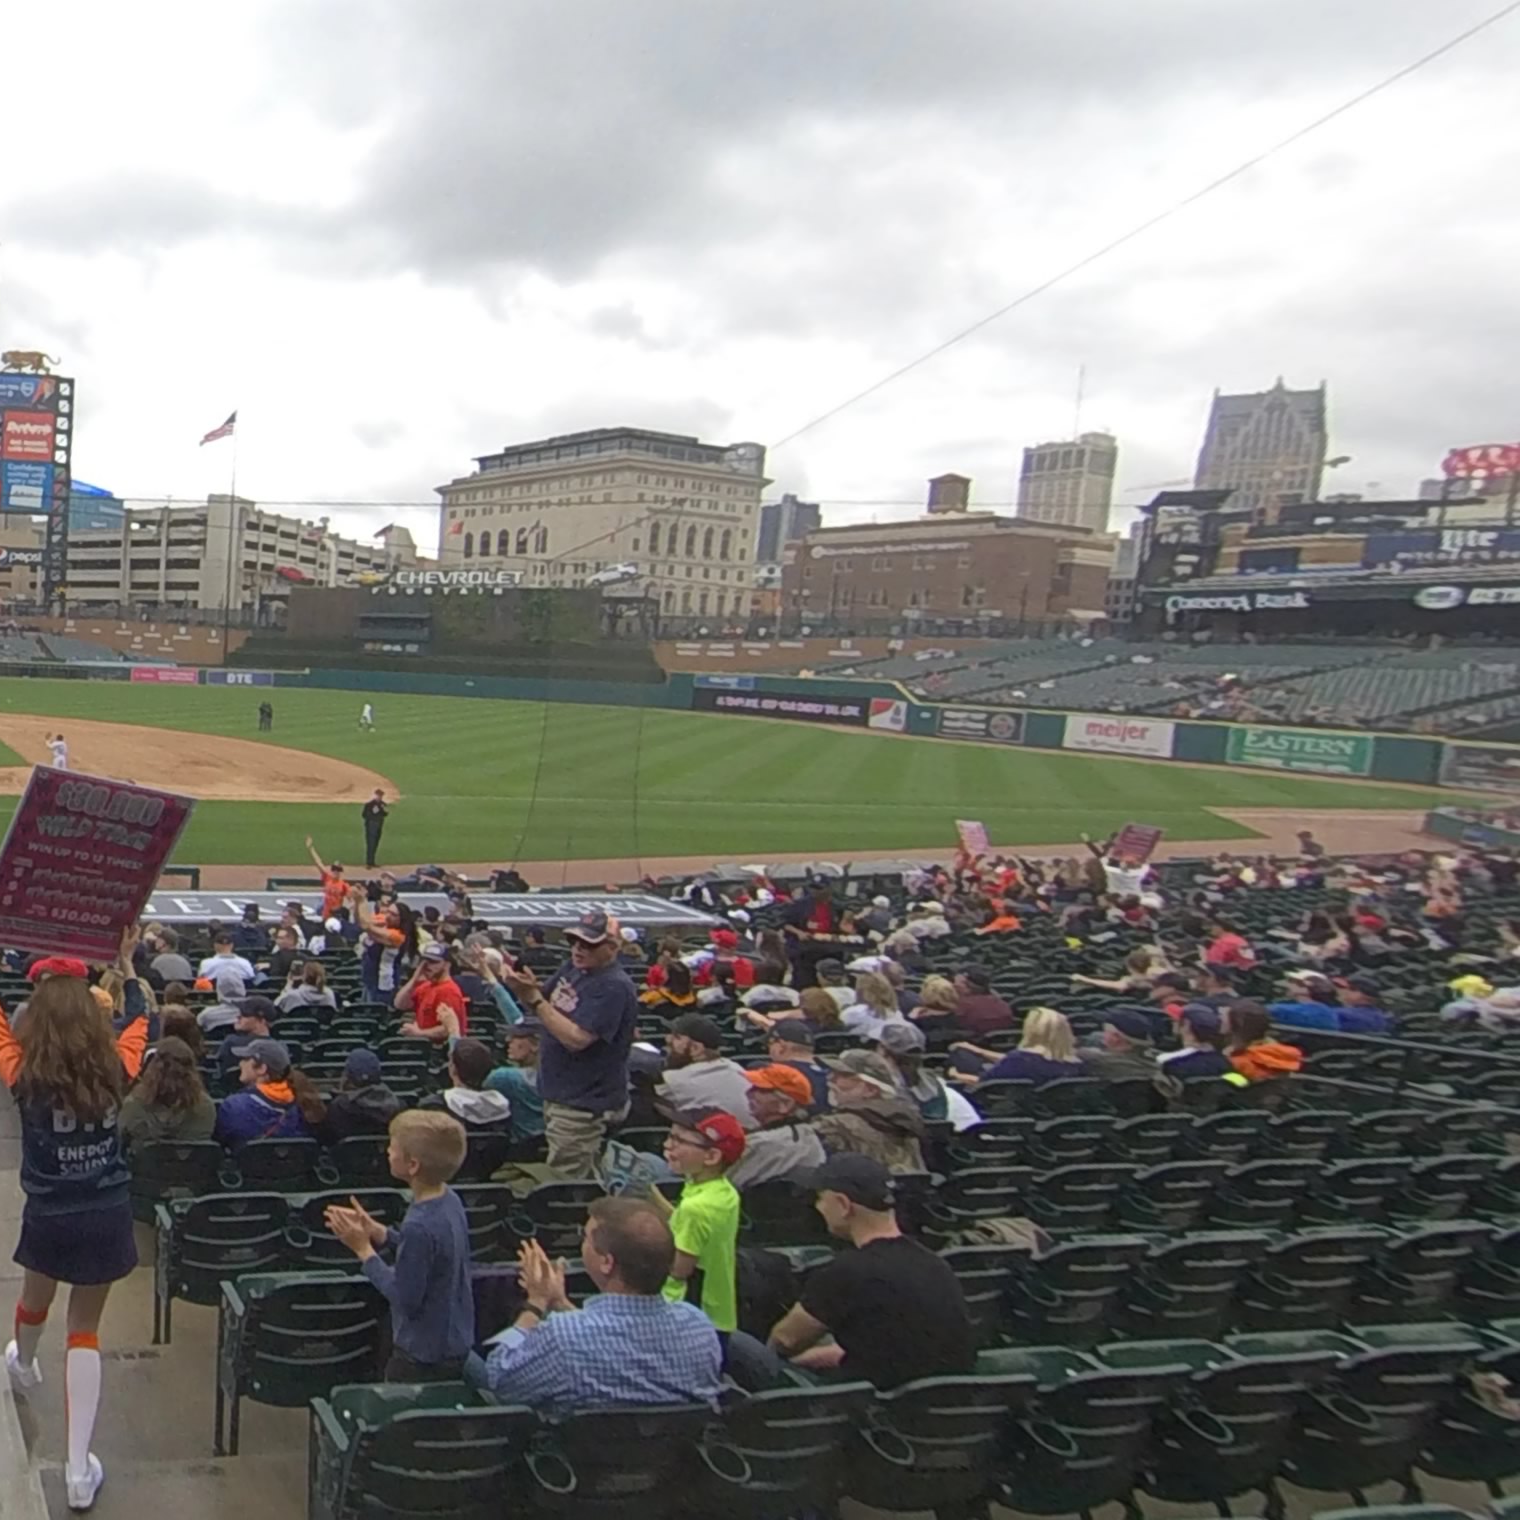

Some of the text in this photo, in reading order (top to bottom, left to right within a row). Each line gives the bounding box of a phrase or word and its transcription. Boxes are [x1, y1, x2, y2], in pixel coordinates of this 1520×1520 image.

[9, 551, 41, 564] pepsi
[396, 571, 524, 585] CHEVROLET
[1255, 592, 1310, 608] Bank
[227, 673, 253, 684] DTE
[1086, 721, 1150, 742] meijer
[1244, 728, 1357, 754] EASTERN
[28, 842, 53, 856] WIN
[54, 845, 72, 858] UP
[74, 849, 90, 861] TO
[58, 1136, 113, 1160] ENERGY
